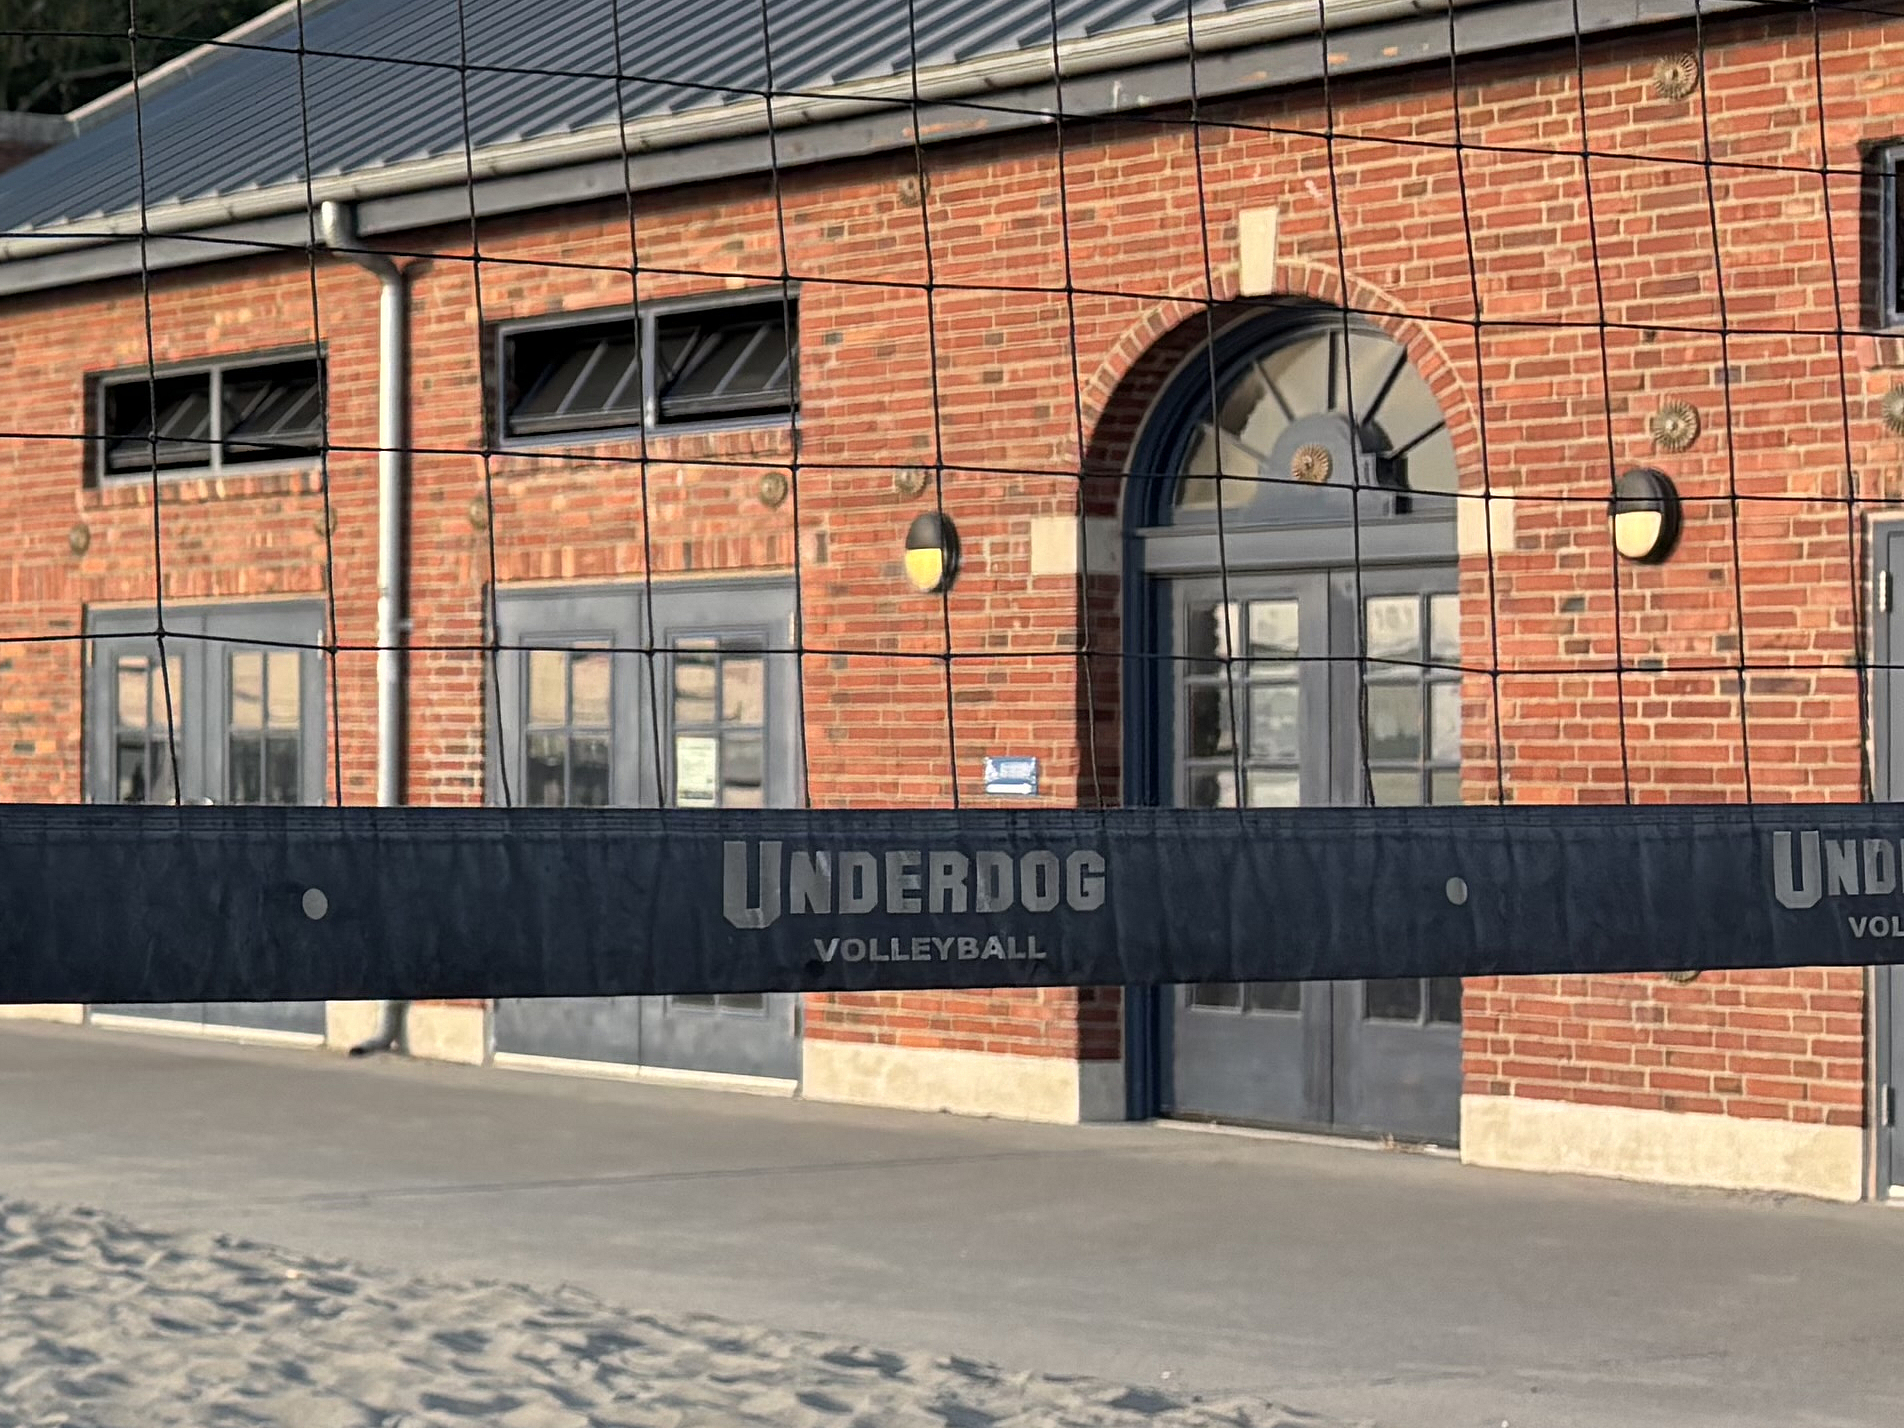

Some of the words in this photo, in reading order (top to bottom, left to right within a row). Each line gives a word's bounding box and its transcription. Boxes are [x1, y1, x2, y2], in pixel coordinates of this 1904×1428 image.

[723, 840, 1106, 929] UNDERDOG
[1773, 830, 1904, 909] UND
[814, 935, 1047, 962] VOLLEYBALL
